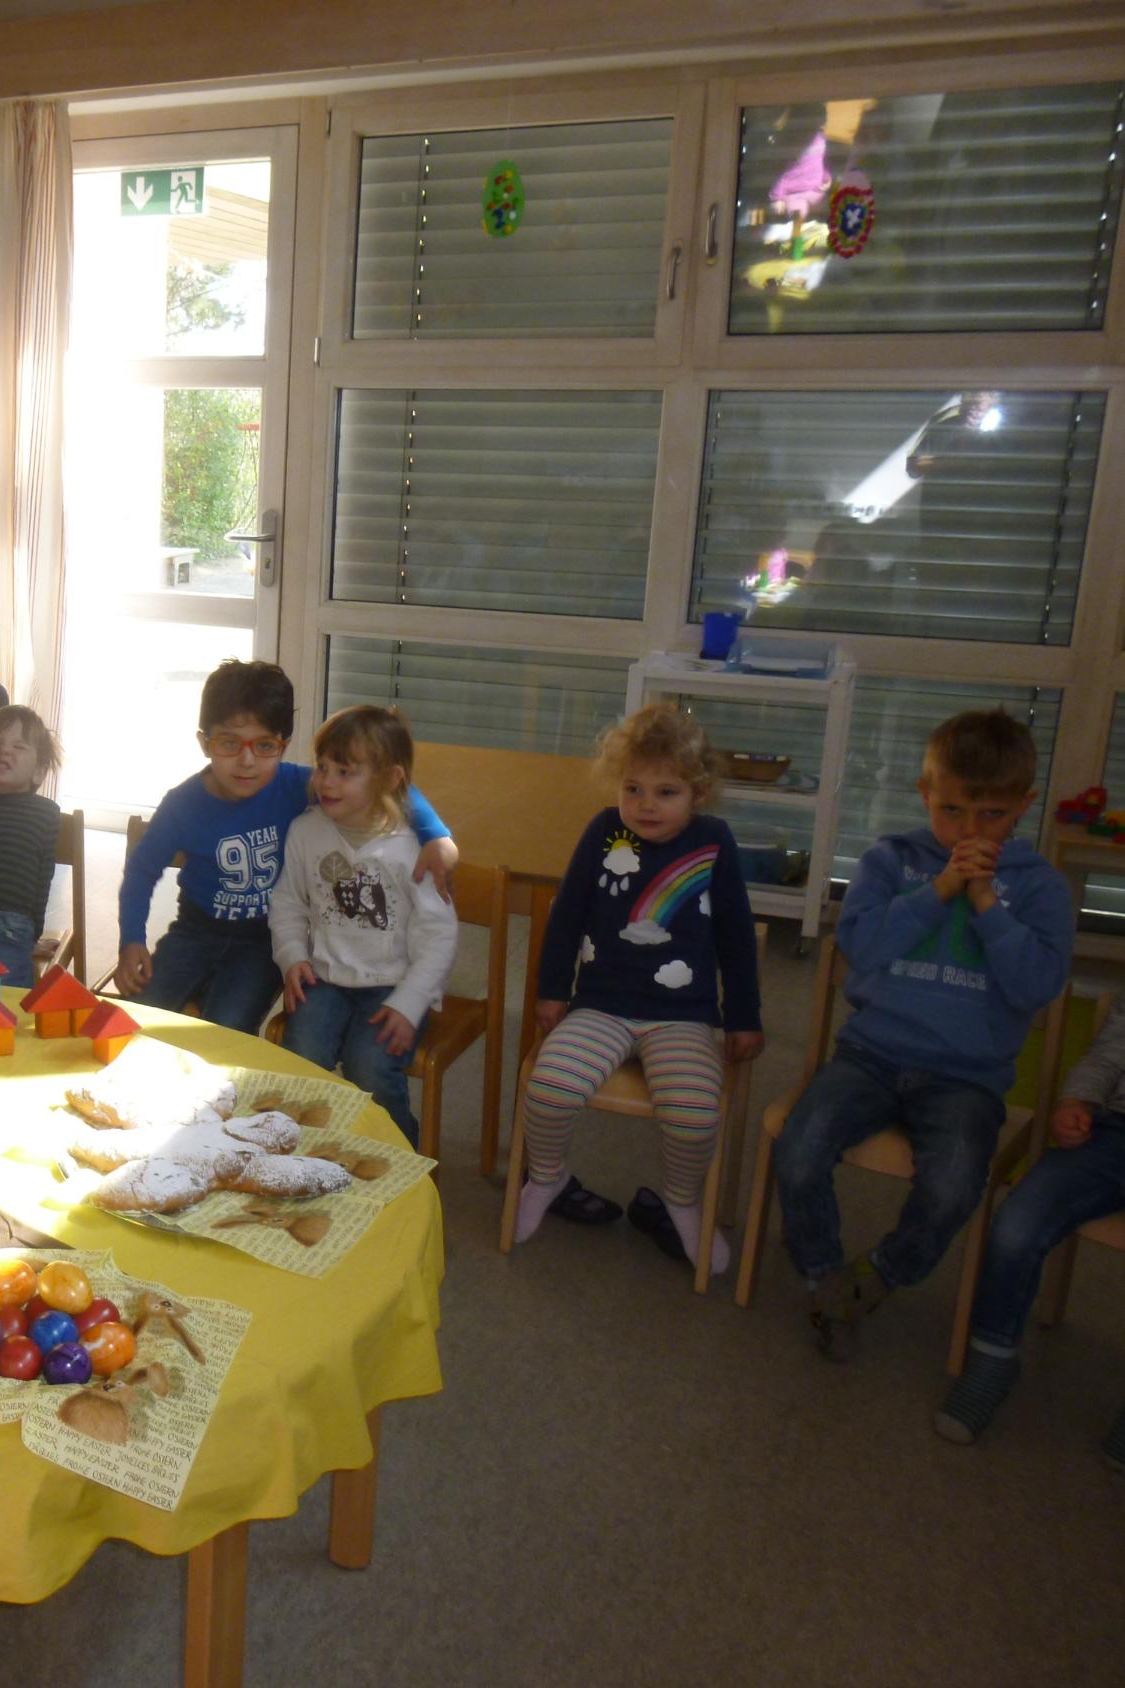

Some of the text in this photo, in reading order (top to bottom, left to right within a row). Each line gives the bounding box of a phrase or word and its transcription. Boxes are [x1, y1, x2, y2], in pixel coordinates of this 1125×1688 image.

[246, 825, 278, 847] YEAH
[216, 834, 278, 892] 95
[83, 1439, 112, 1457] EASTER
[64, 1444, 88, 1459] HAPPY
[88, 1455, 119, 1473] EASTER
[148, 1480, 179, 1498] OSTERN
[153, 1452, 180, 1470] OSTERN
[123, 1482, 146, 1498] HAPPY
[147, 1493, 173, 1510] EASTER
